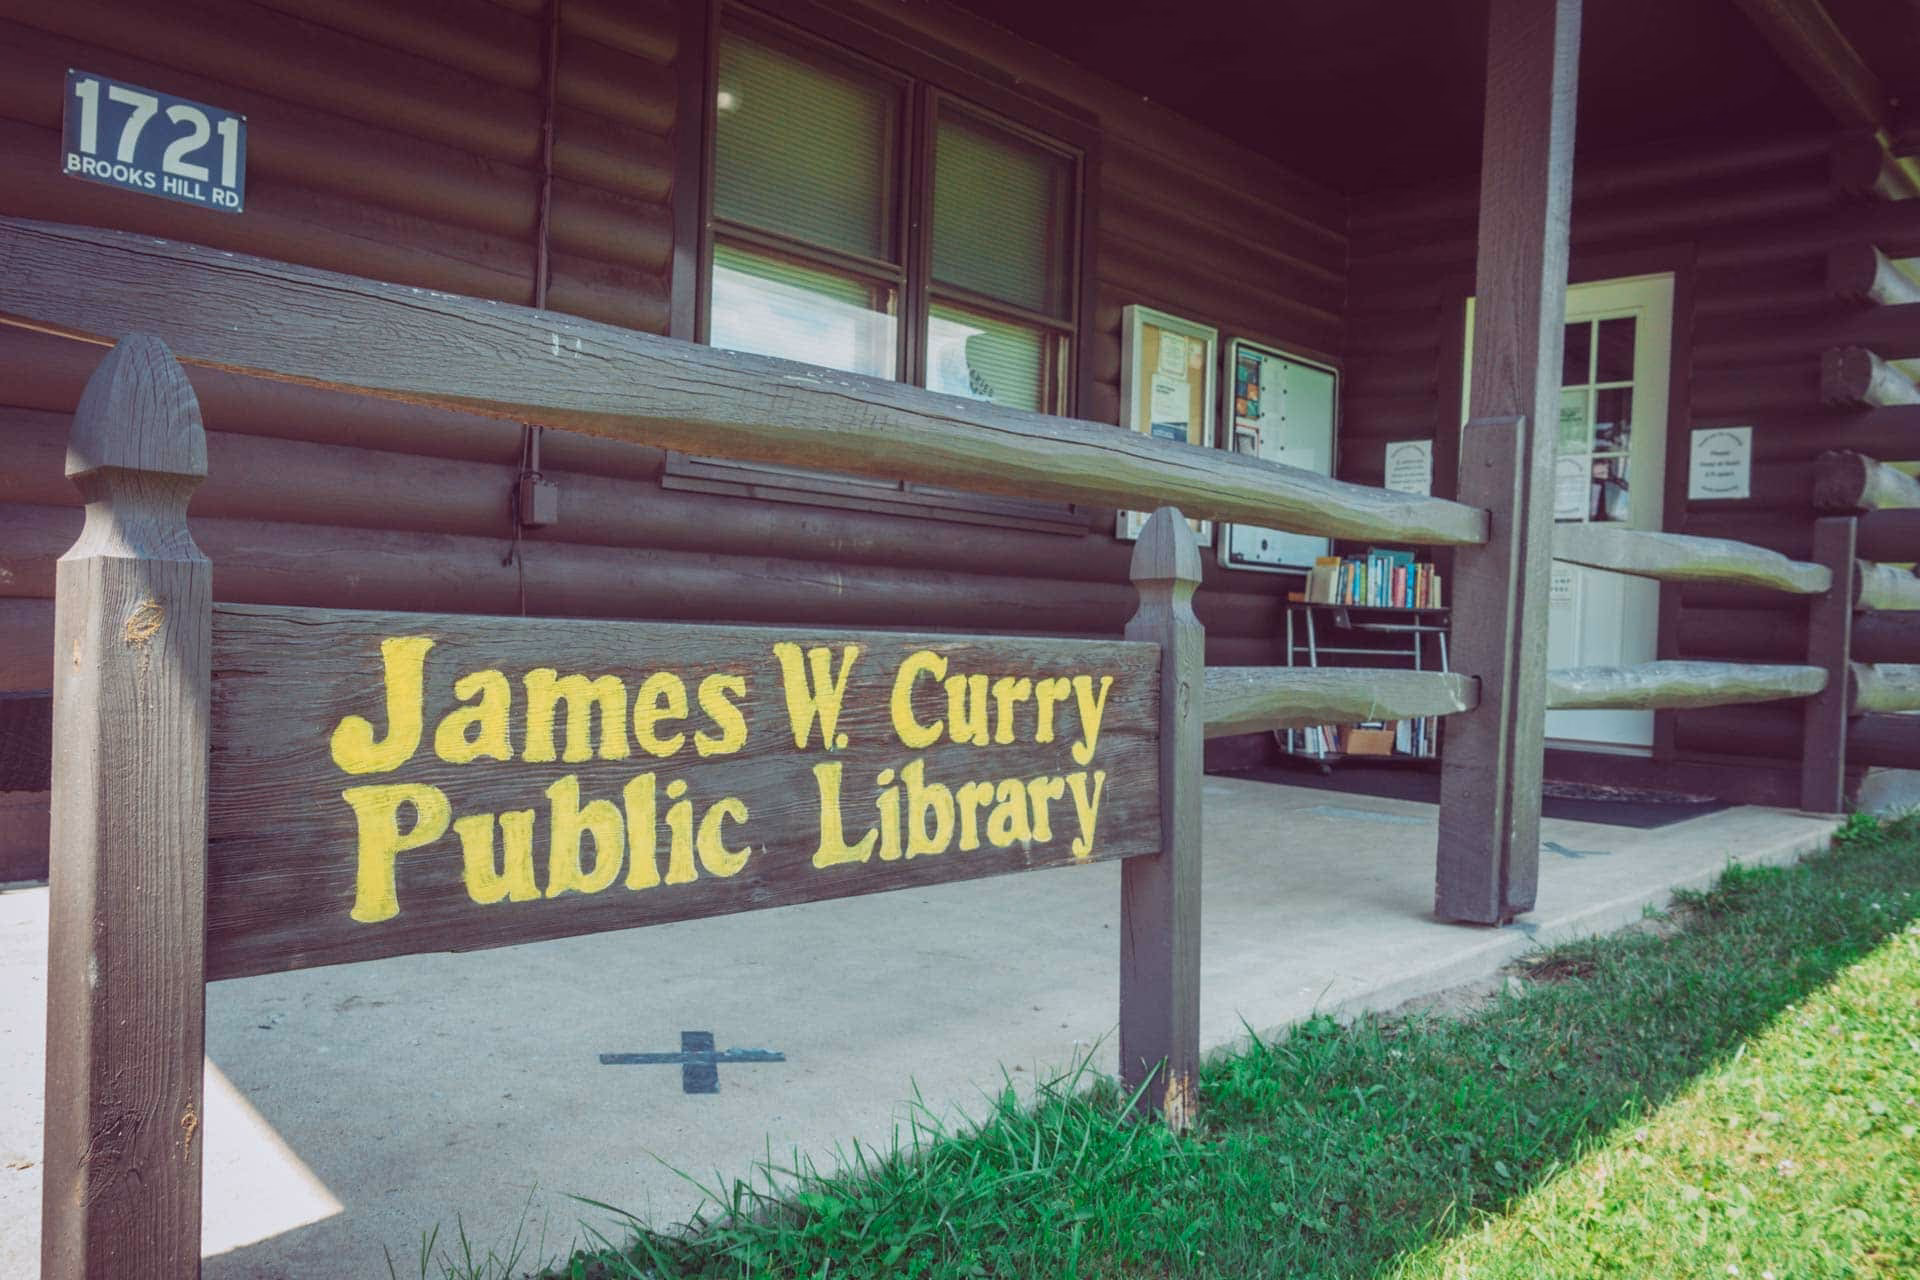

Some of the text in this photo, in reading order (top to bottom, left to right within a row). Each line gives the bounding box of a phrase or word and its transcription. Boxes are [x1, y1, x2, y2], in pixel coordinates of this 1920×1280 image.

[67, 152, 239, 208] BROOKS HILL RD
[75, 78, 239, 188] 1721
[330, 636, 1114, 775] James W. Curry
[342, 758, 1106, 923] Public Library
